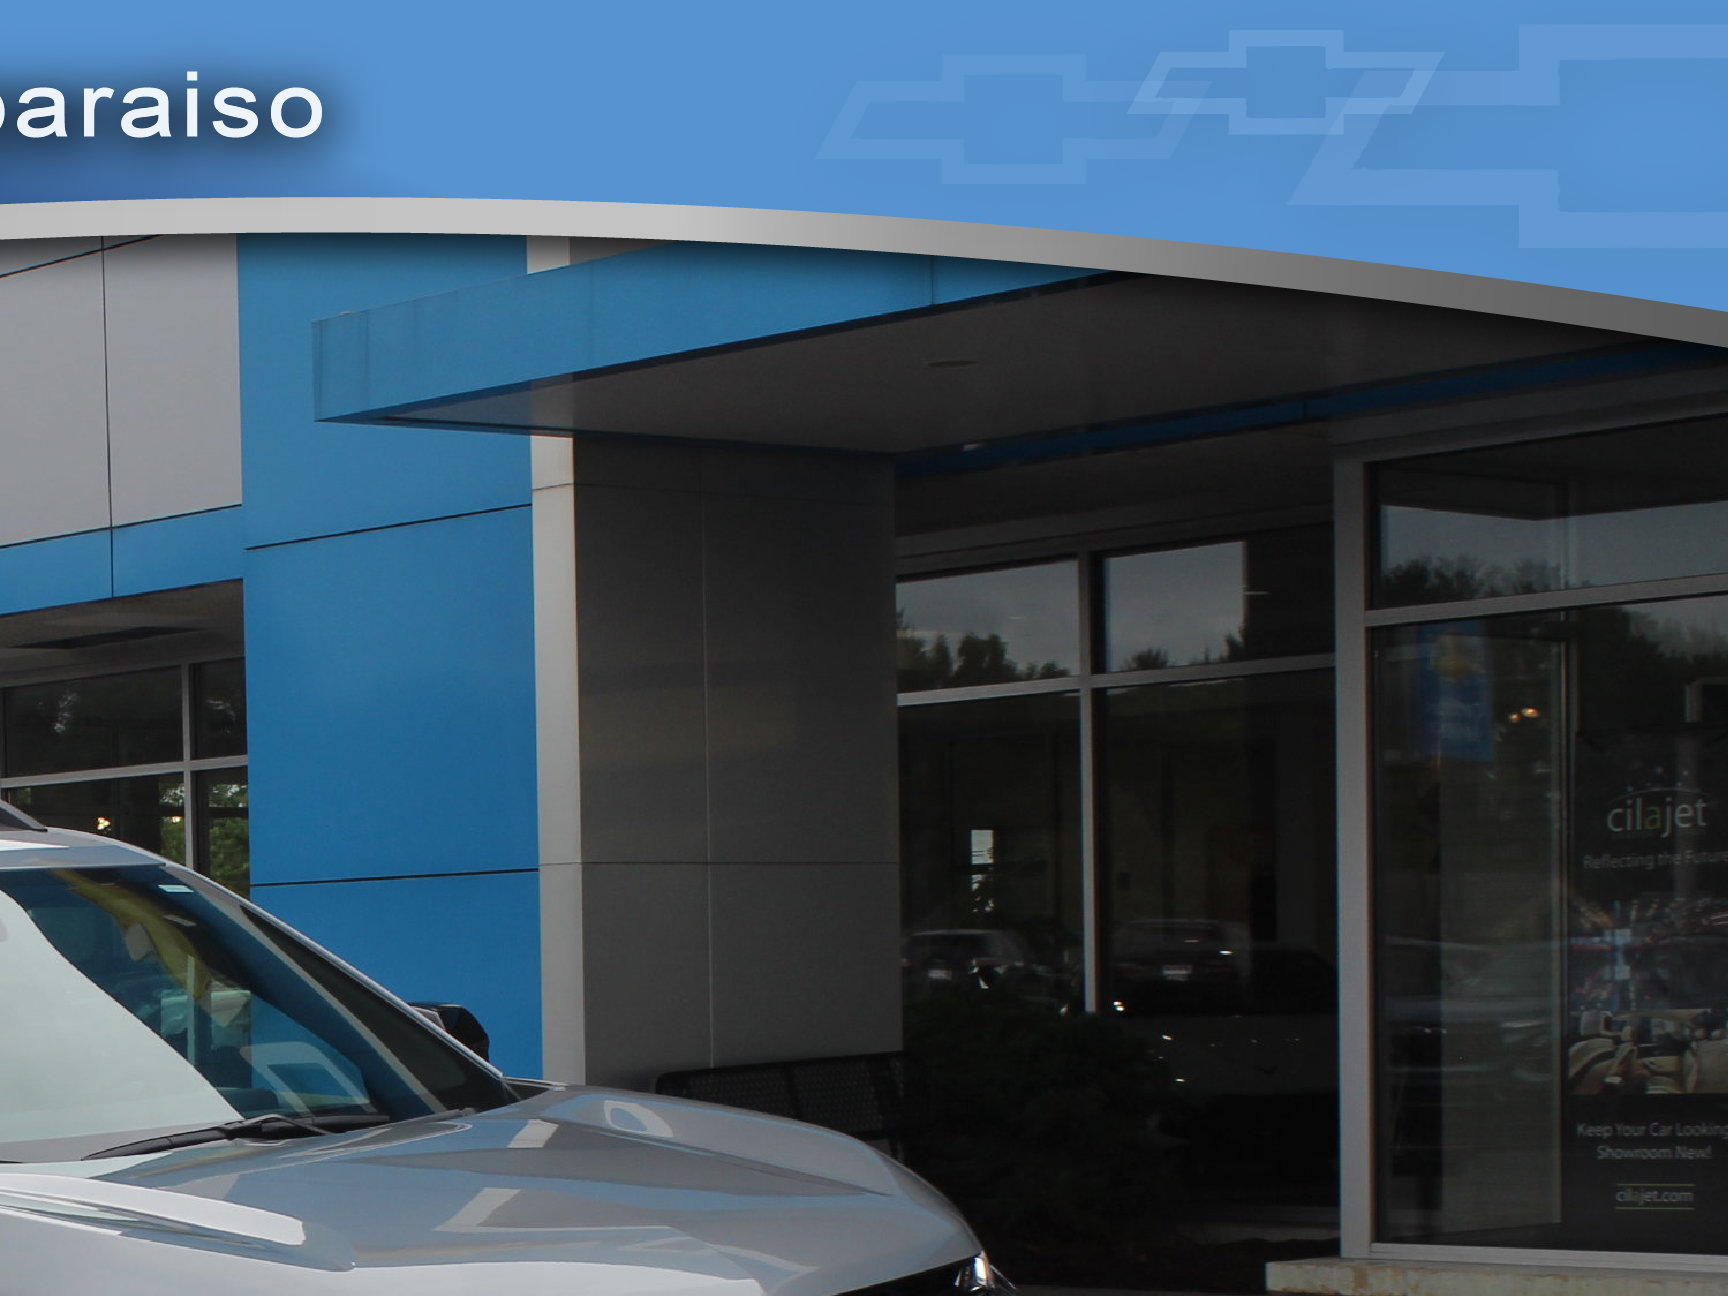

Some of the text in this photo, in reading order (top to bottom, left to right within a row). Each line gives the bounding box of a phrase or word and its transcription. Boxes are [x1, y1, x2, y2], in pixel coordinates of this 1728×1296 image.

[1606, 797, 1707, 838] cilajet
[1576, 1122, 1612, 1139] Keep
[1614, 1122, 1646, 1137] Your
[1649, 1122, 1672, 1137] Car
[1596, 1145, 1672, 1160] Showroom
